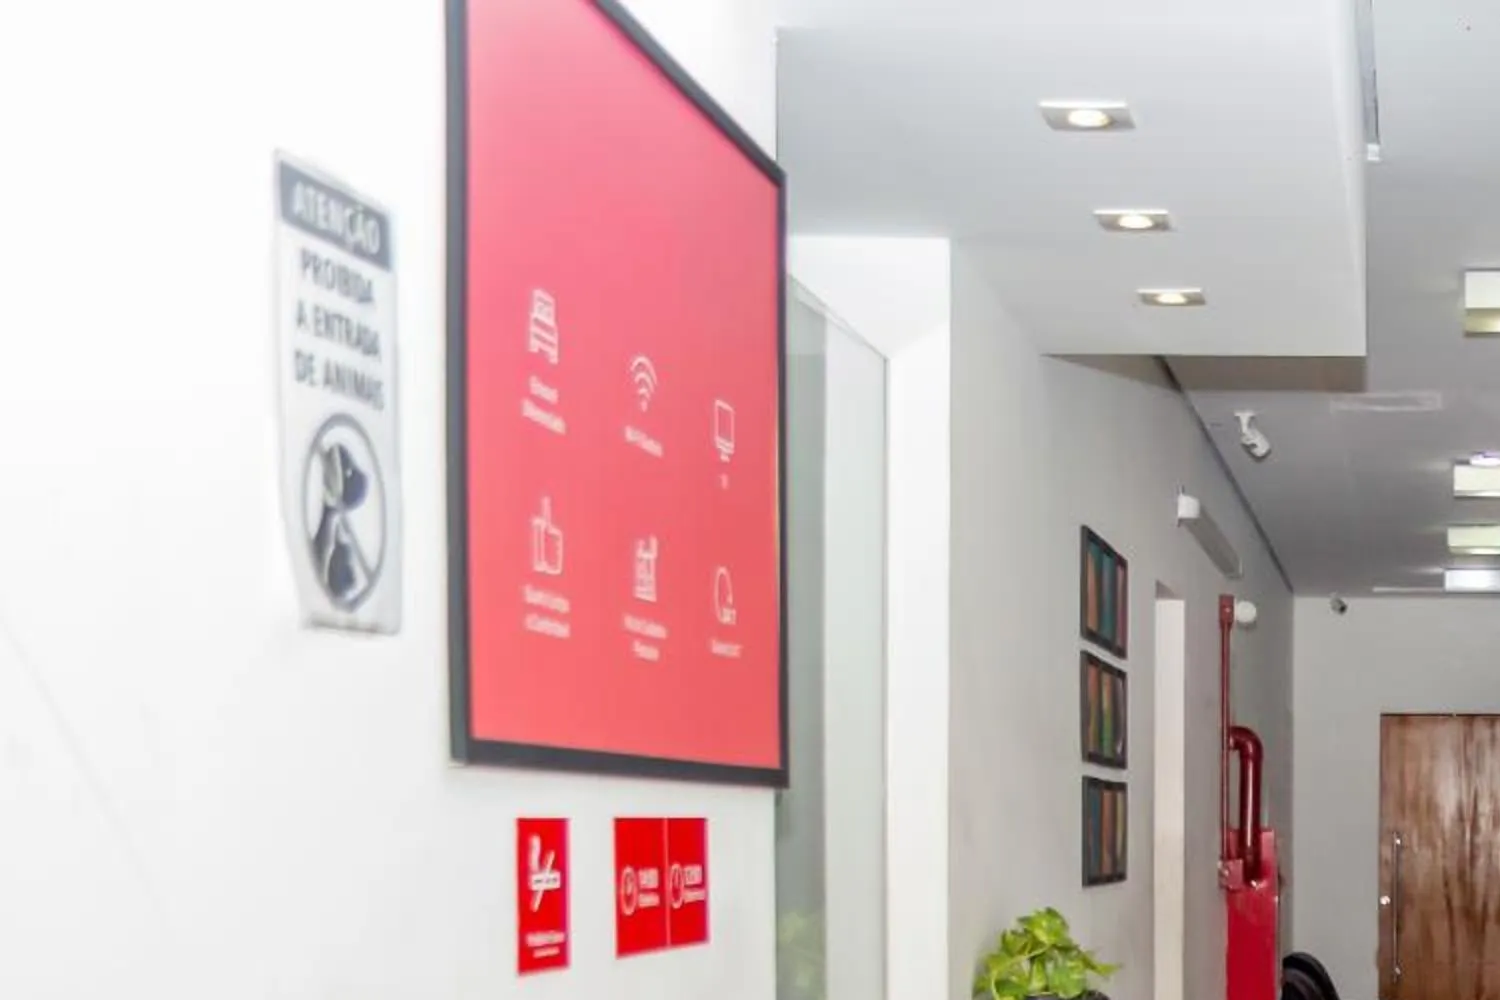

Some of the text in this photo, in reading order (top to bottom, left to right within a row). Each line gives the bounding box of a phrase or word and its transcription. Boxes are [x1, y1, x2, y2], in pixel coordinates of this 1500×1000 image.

[293, 180, 380, 255] ATENÇÃO
[296, 298, 310, 331] A
[294, 348, 316, 388] DE
